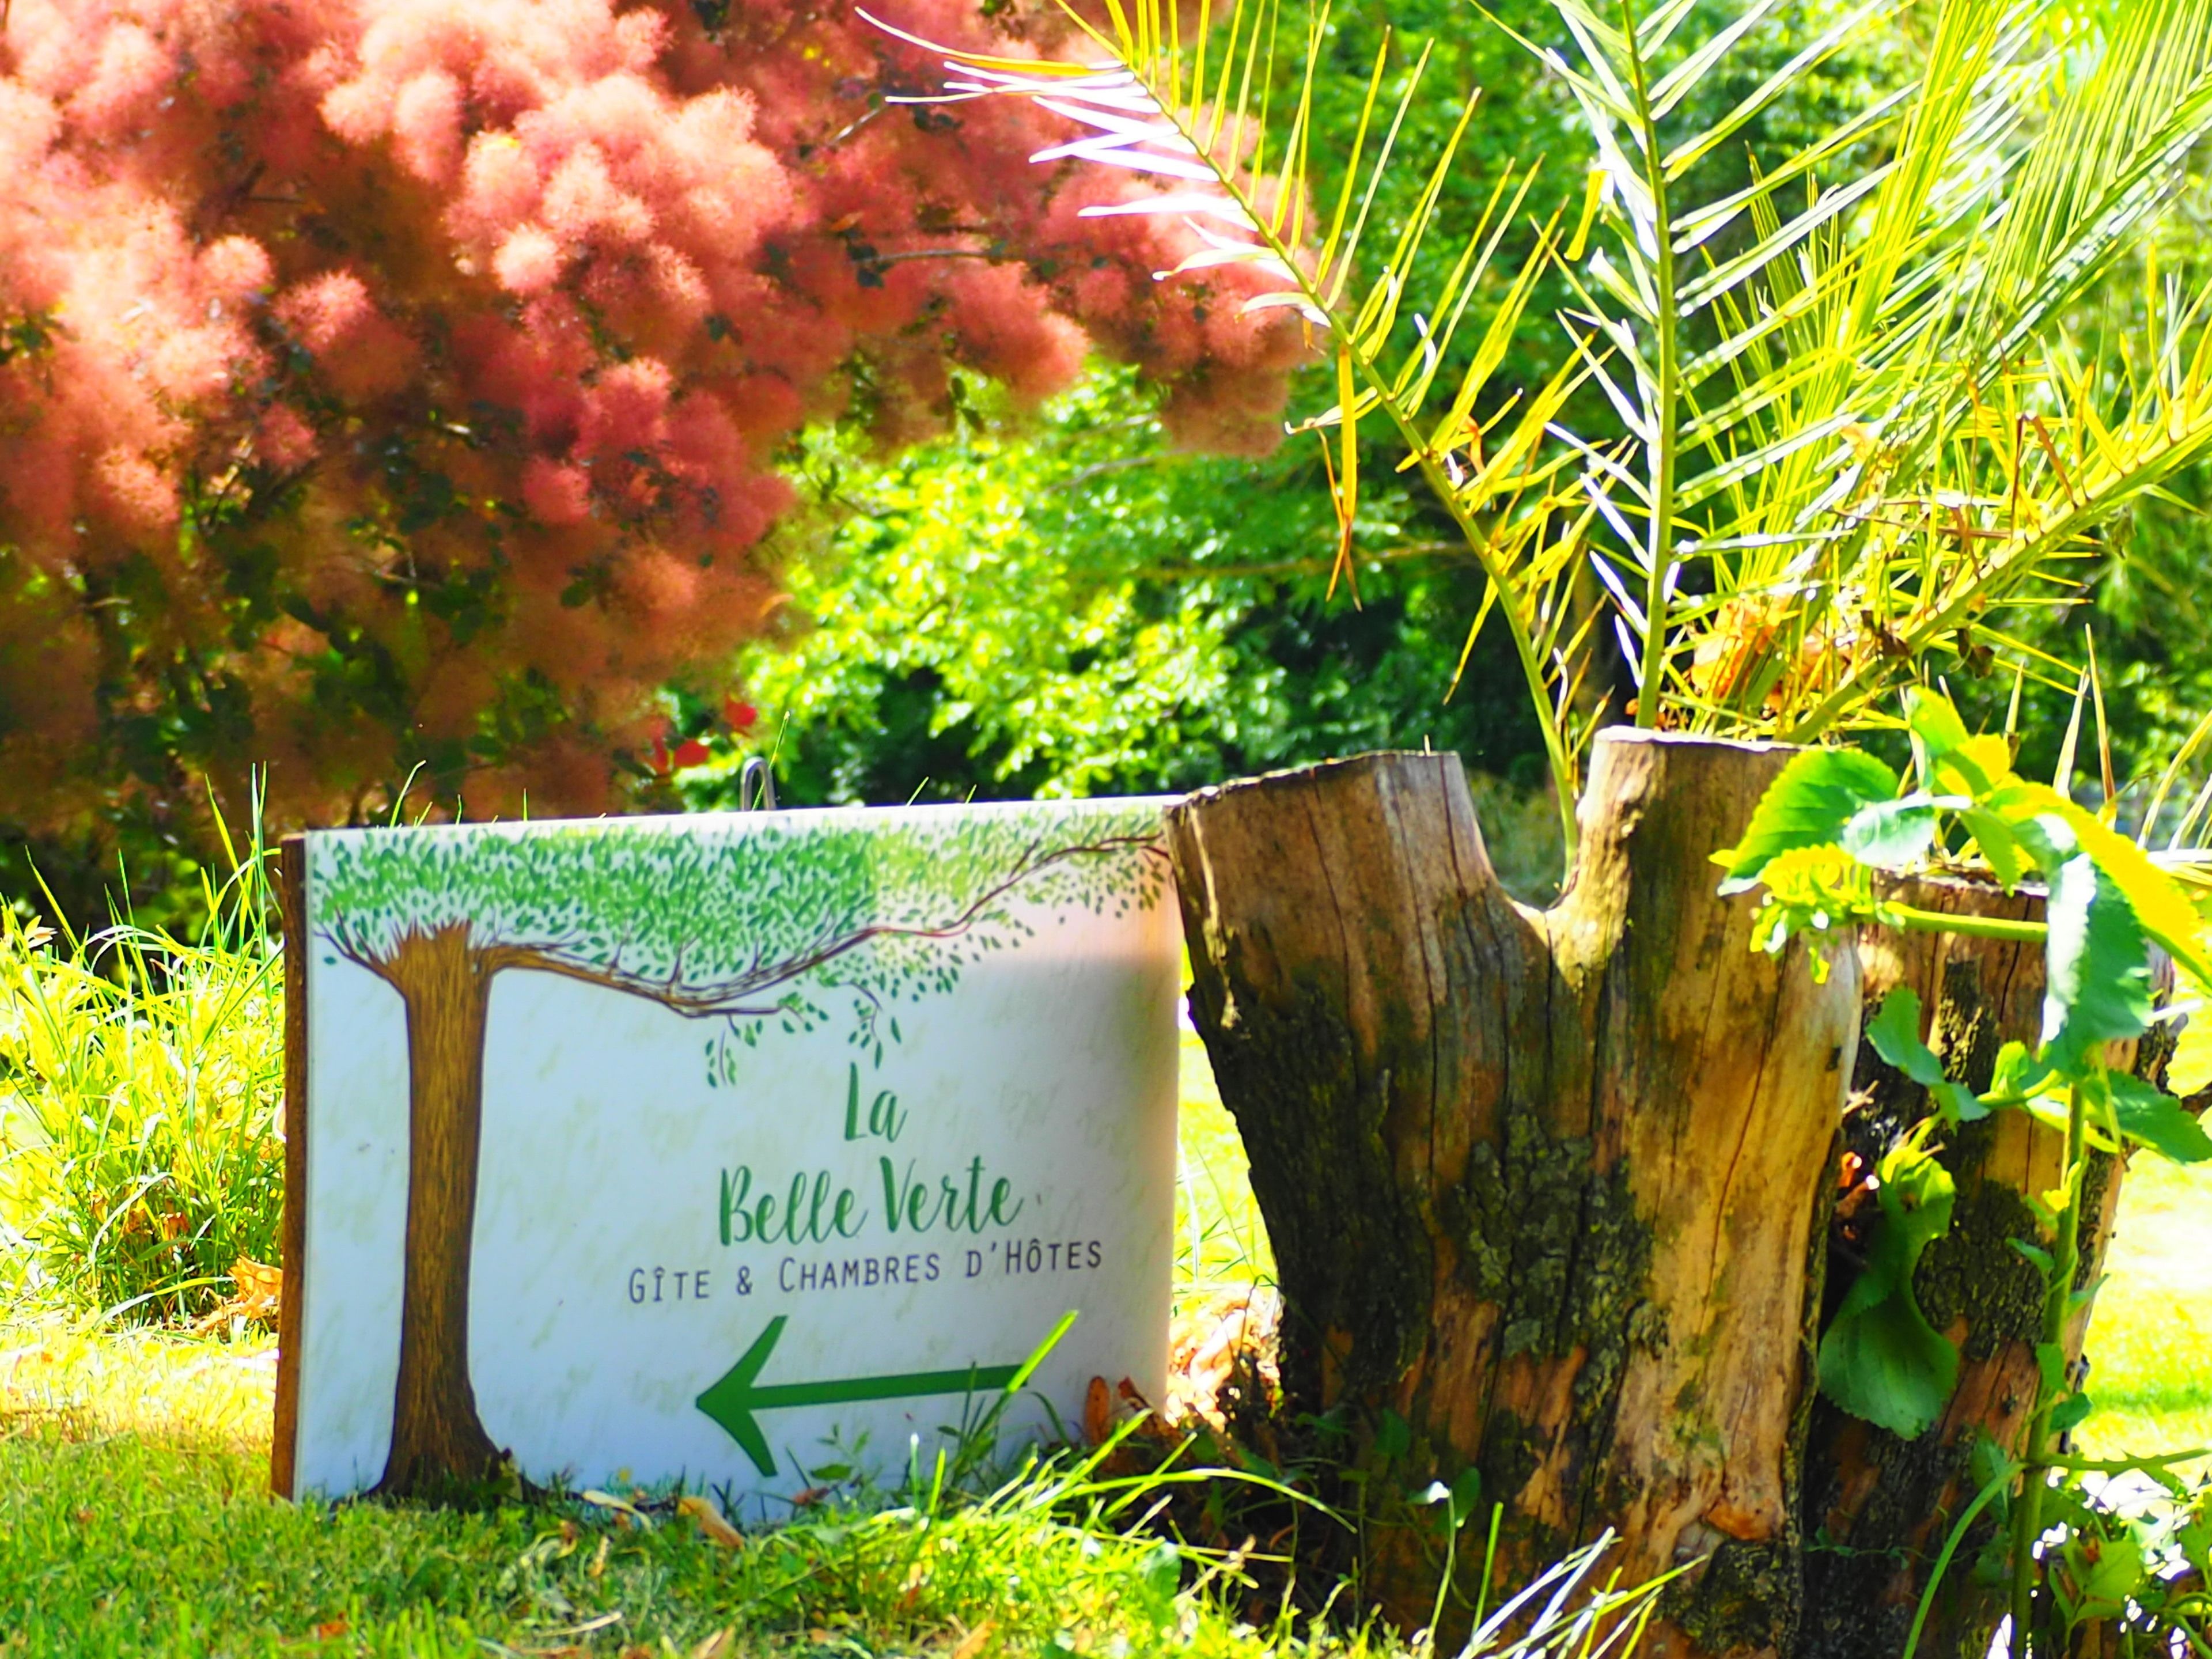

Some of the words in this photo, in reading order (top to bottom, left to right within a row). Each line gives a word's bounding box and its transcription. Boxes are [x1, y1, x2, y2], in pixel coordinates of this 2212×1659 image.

[844, 1062, 907, 1142] La
[719, 1165, 869, 1247] Belle
[880, 1155, 1024, 1233] Verte
[629, 1267, 710, 1304] GÎTE
[737, 1267, 753, 1296] &
[779, 1253, 941, 1293] CHAMBRES
[965, 1238, 1103, 1278] D'HÔTES
